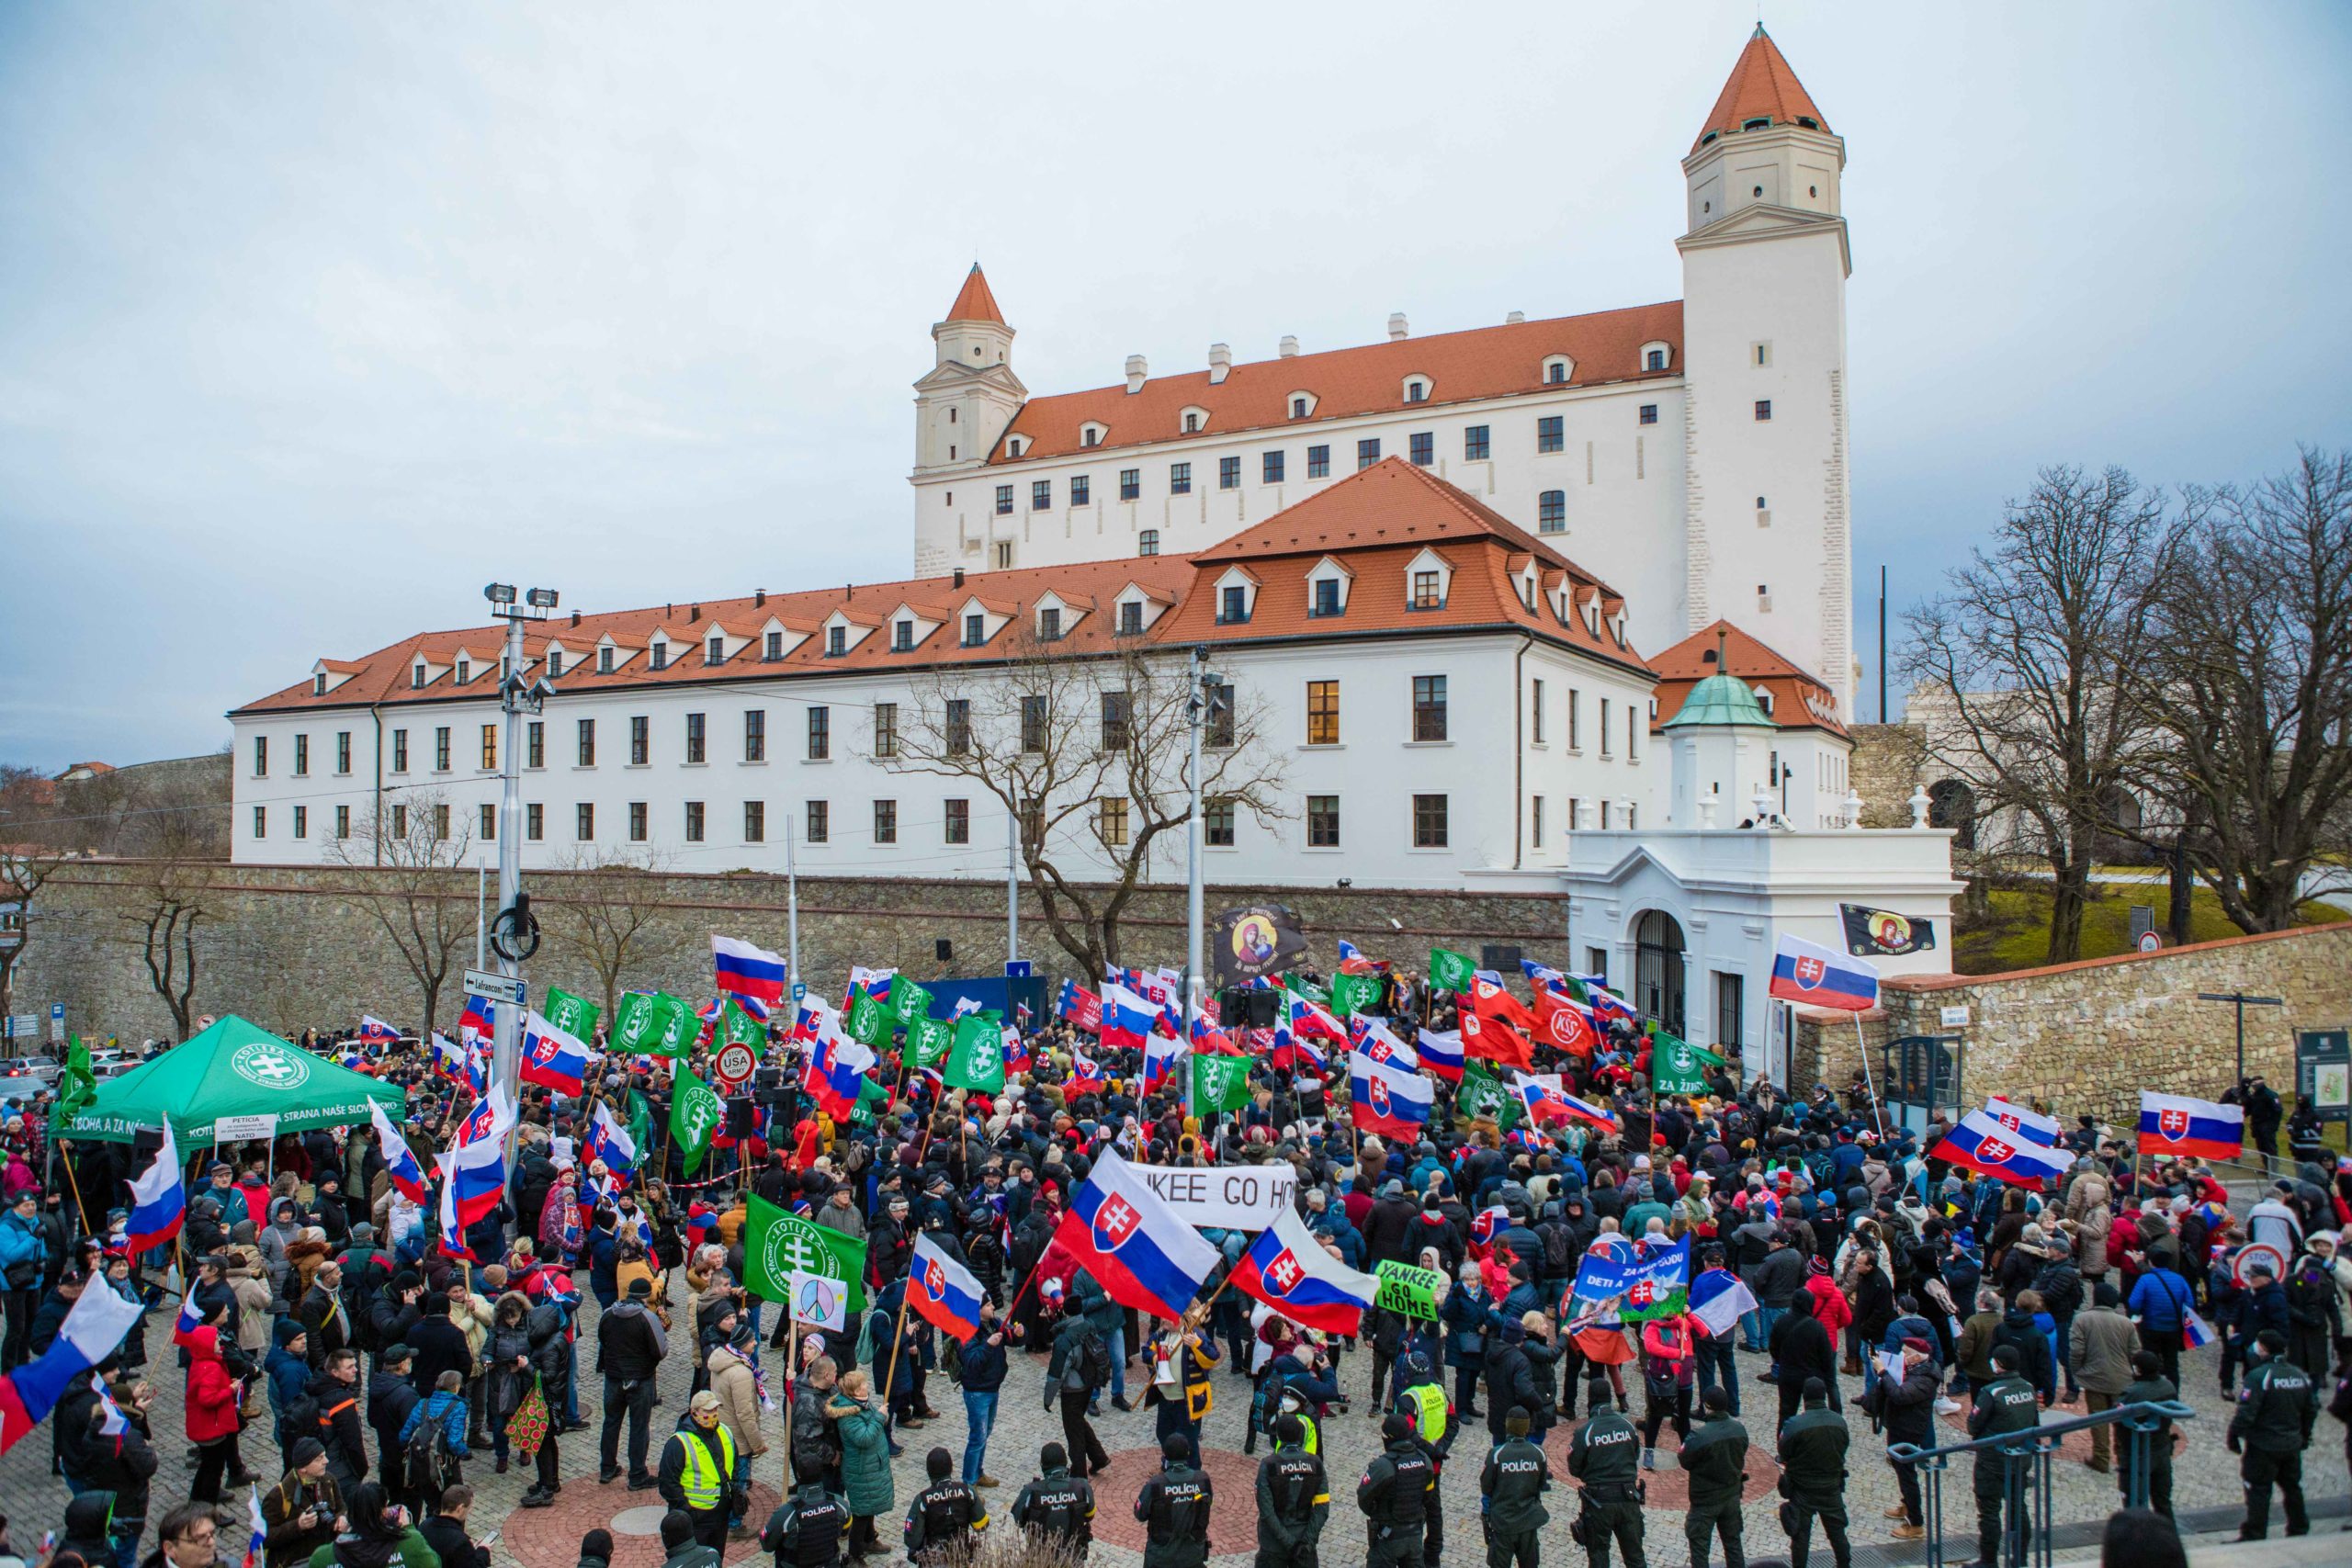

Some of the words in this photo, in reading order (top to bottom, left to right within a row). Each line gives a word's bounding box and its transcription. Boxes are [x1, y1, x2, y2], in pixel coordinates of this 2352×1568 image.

[475, 977, 503, 994] Lafranconi
[517, 985, 524, 998] P
[236, 1045, 285, 1060] KOTLEBA
[724, 1056, 748, 1068] USA
[1658, 1079, 1675, 1091] ZA
[284, 1109, 320, 1122] STRANA
[322, 1104, 346, 1117] NAŠE
[347, 1101, 397, 1114] SLOVESKO
[77, 1117, 102, 1131] BOHA
[104, 1118, 111, 1129] A
[113, 1118, 124, 1133] ZA
[1224, 1177, 1259, 1206] GO
[2248, 1252, 2273, 1261] STOP
[1380, 1262, 1438, 1290] YANKEE
[1623, 1268, 1636, 1276] ZA
[1587, 1275, 1612, 1288] DETI
[1615, 1280, 1623, 1288] A
[1391, 1282, 1411, 1298] GO
[1382, 1291, 1432, 1319] HOME
[2004, 1390, 2034, 1405] POLÍCIA
[1594, 1429, 1632, 1447] POLÍCIA
[1281, 1460, 1312, 1474] POLÍCIA
[1397, 1460, 1425, 1471] POLÍCIA
[1501, 1459, 1539, 1473] POLÍCIA
[1165, 1483, 1201, 1496] POLÍCIA
[1040, 1492, 1078, 1506] POLÍCIA
[800, 1505, 836, 1518] POLÍCIA
